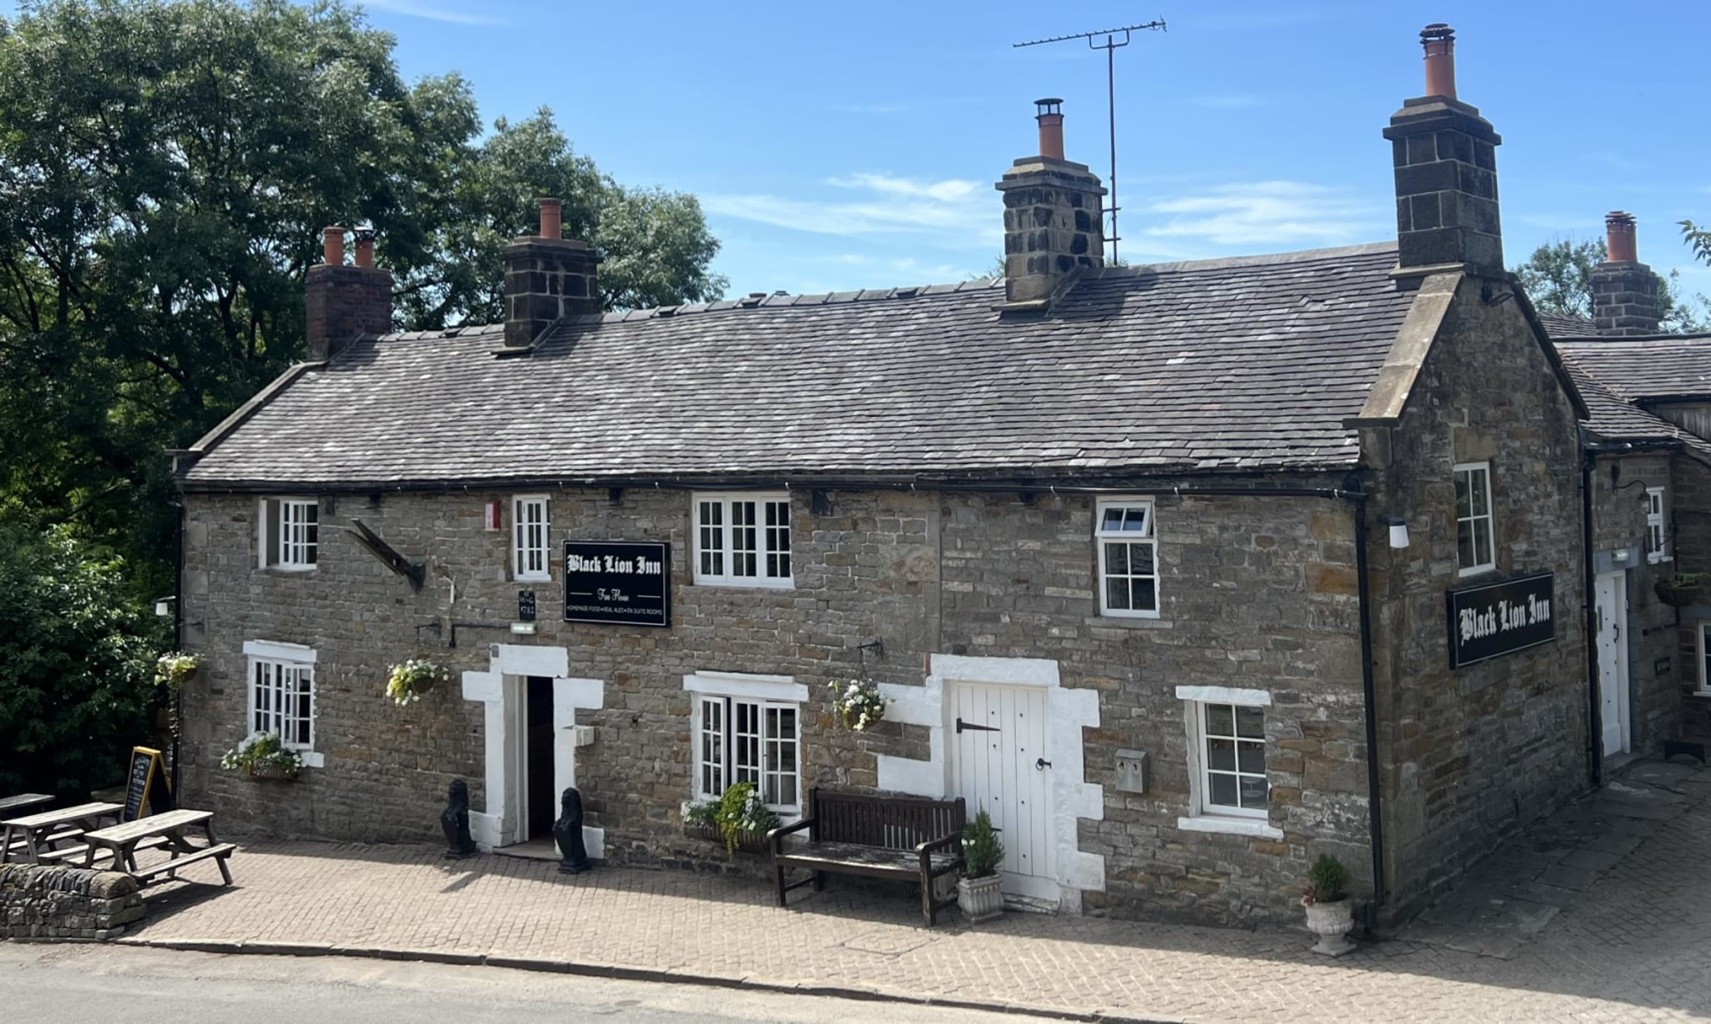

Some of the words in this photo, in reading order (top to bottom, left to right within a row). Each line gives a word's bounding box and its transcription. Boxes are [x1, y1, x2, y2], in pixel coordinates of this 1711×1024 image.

[566, 554, 602, 574] Black
[603, 555, 633, 574] Lion
[635, 556, 661, 575] Inn
[597, 588, 610, 601] Free
[1459, 604, 1497, 647] Black
[1498, 599, 1526, 633] Lion
[1528, 593, 1550, 625] Inn
